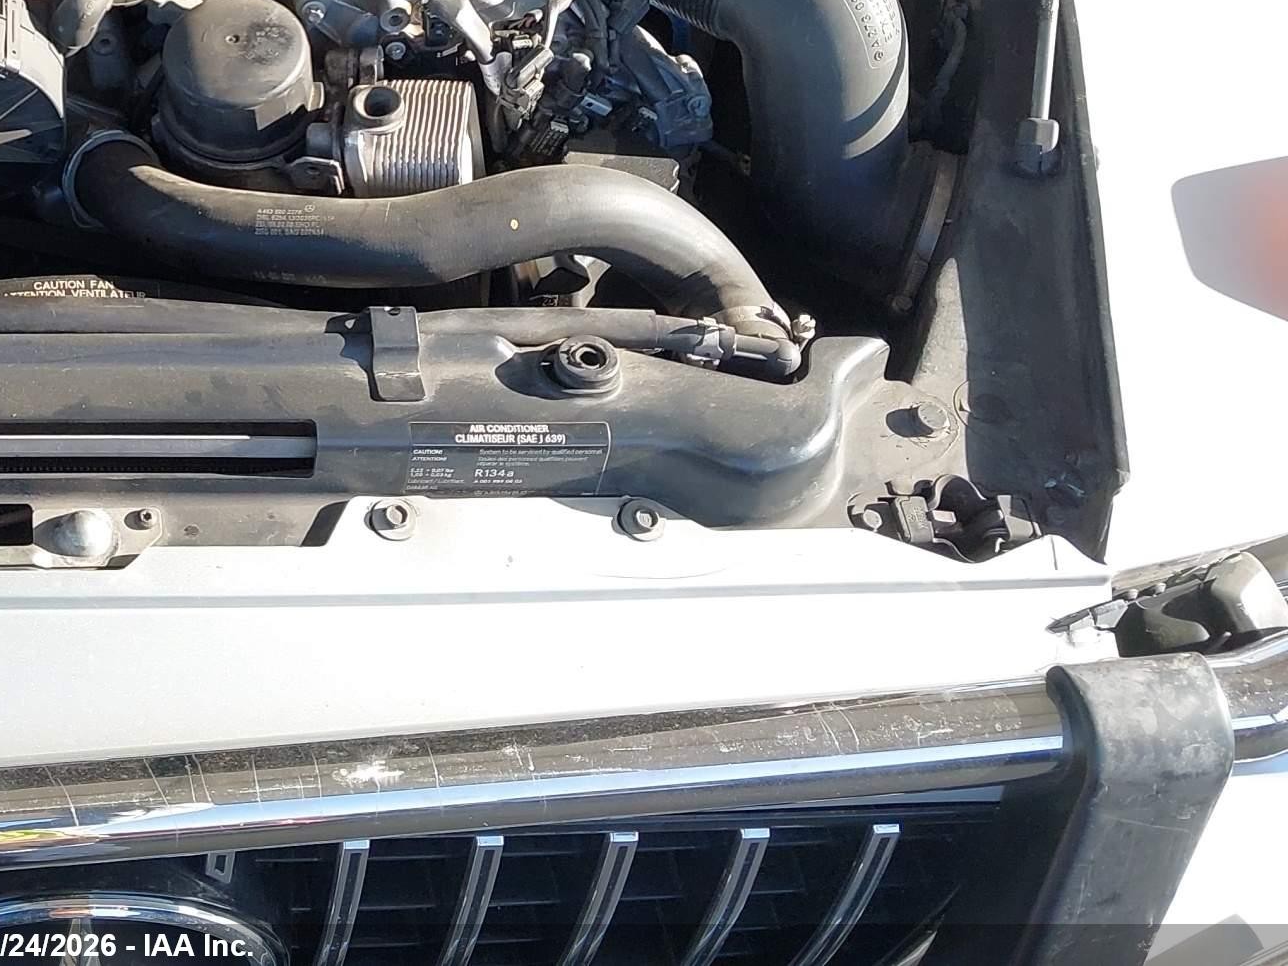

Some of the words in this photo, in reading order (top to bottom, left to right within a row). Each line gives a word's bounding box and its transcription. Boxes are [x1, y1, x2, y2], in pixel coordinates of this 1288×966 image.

[33, 280, 85, 290] CAUTION
[90, 280, 115, 290] FAN
[469, 424, 485, 433] AIR
[486, 424, 549, 433] CONDITIONER
[455, 434, 516, 444] CLIMATISEUR
[517, 434, 537, 445] (SAE
[538, 434, 544, 444] J
[545, 434, 566, 445] 639)
